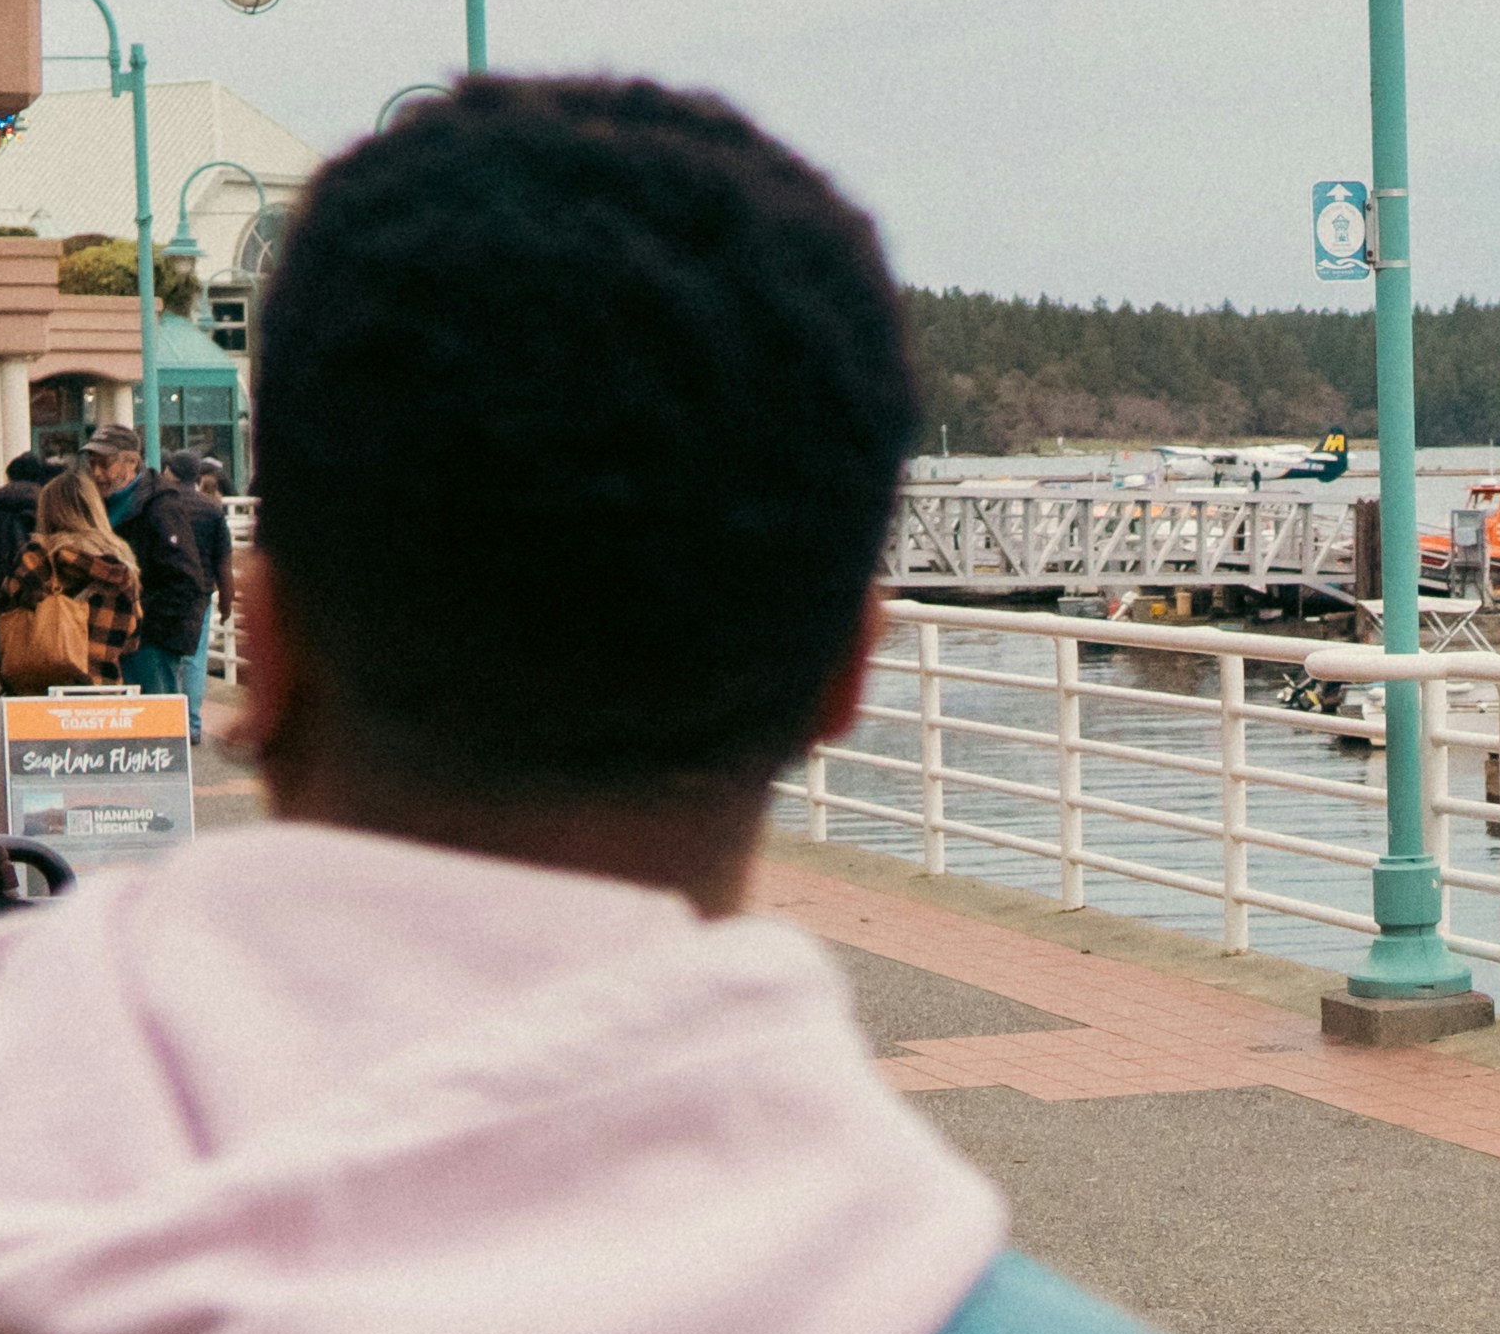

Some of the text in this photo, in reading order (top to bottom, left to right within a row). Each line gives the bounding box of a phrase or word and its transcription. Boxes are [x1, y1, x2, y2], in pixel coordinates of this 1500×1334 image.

[60, 716, 133, 730] COAST AIR
[22, 746, 174, 778] Seaplane Flights
[94, 809, 154, 822] NANAIMO
[95, 821, 149, 834] SECHELT
